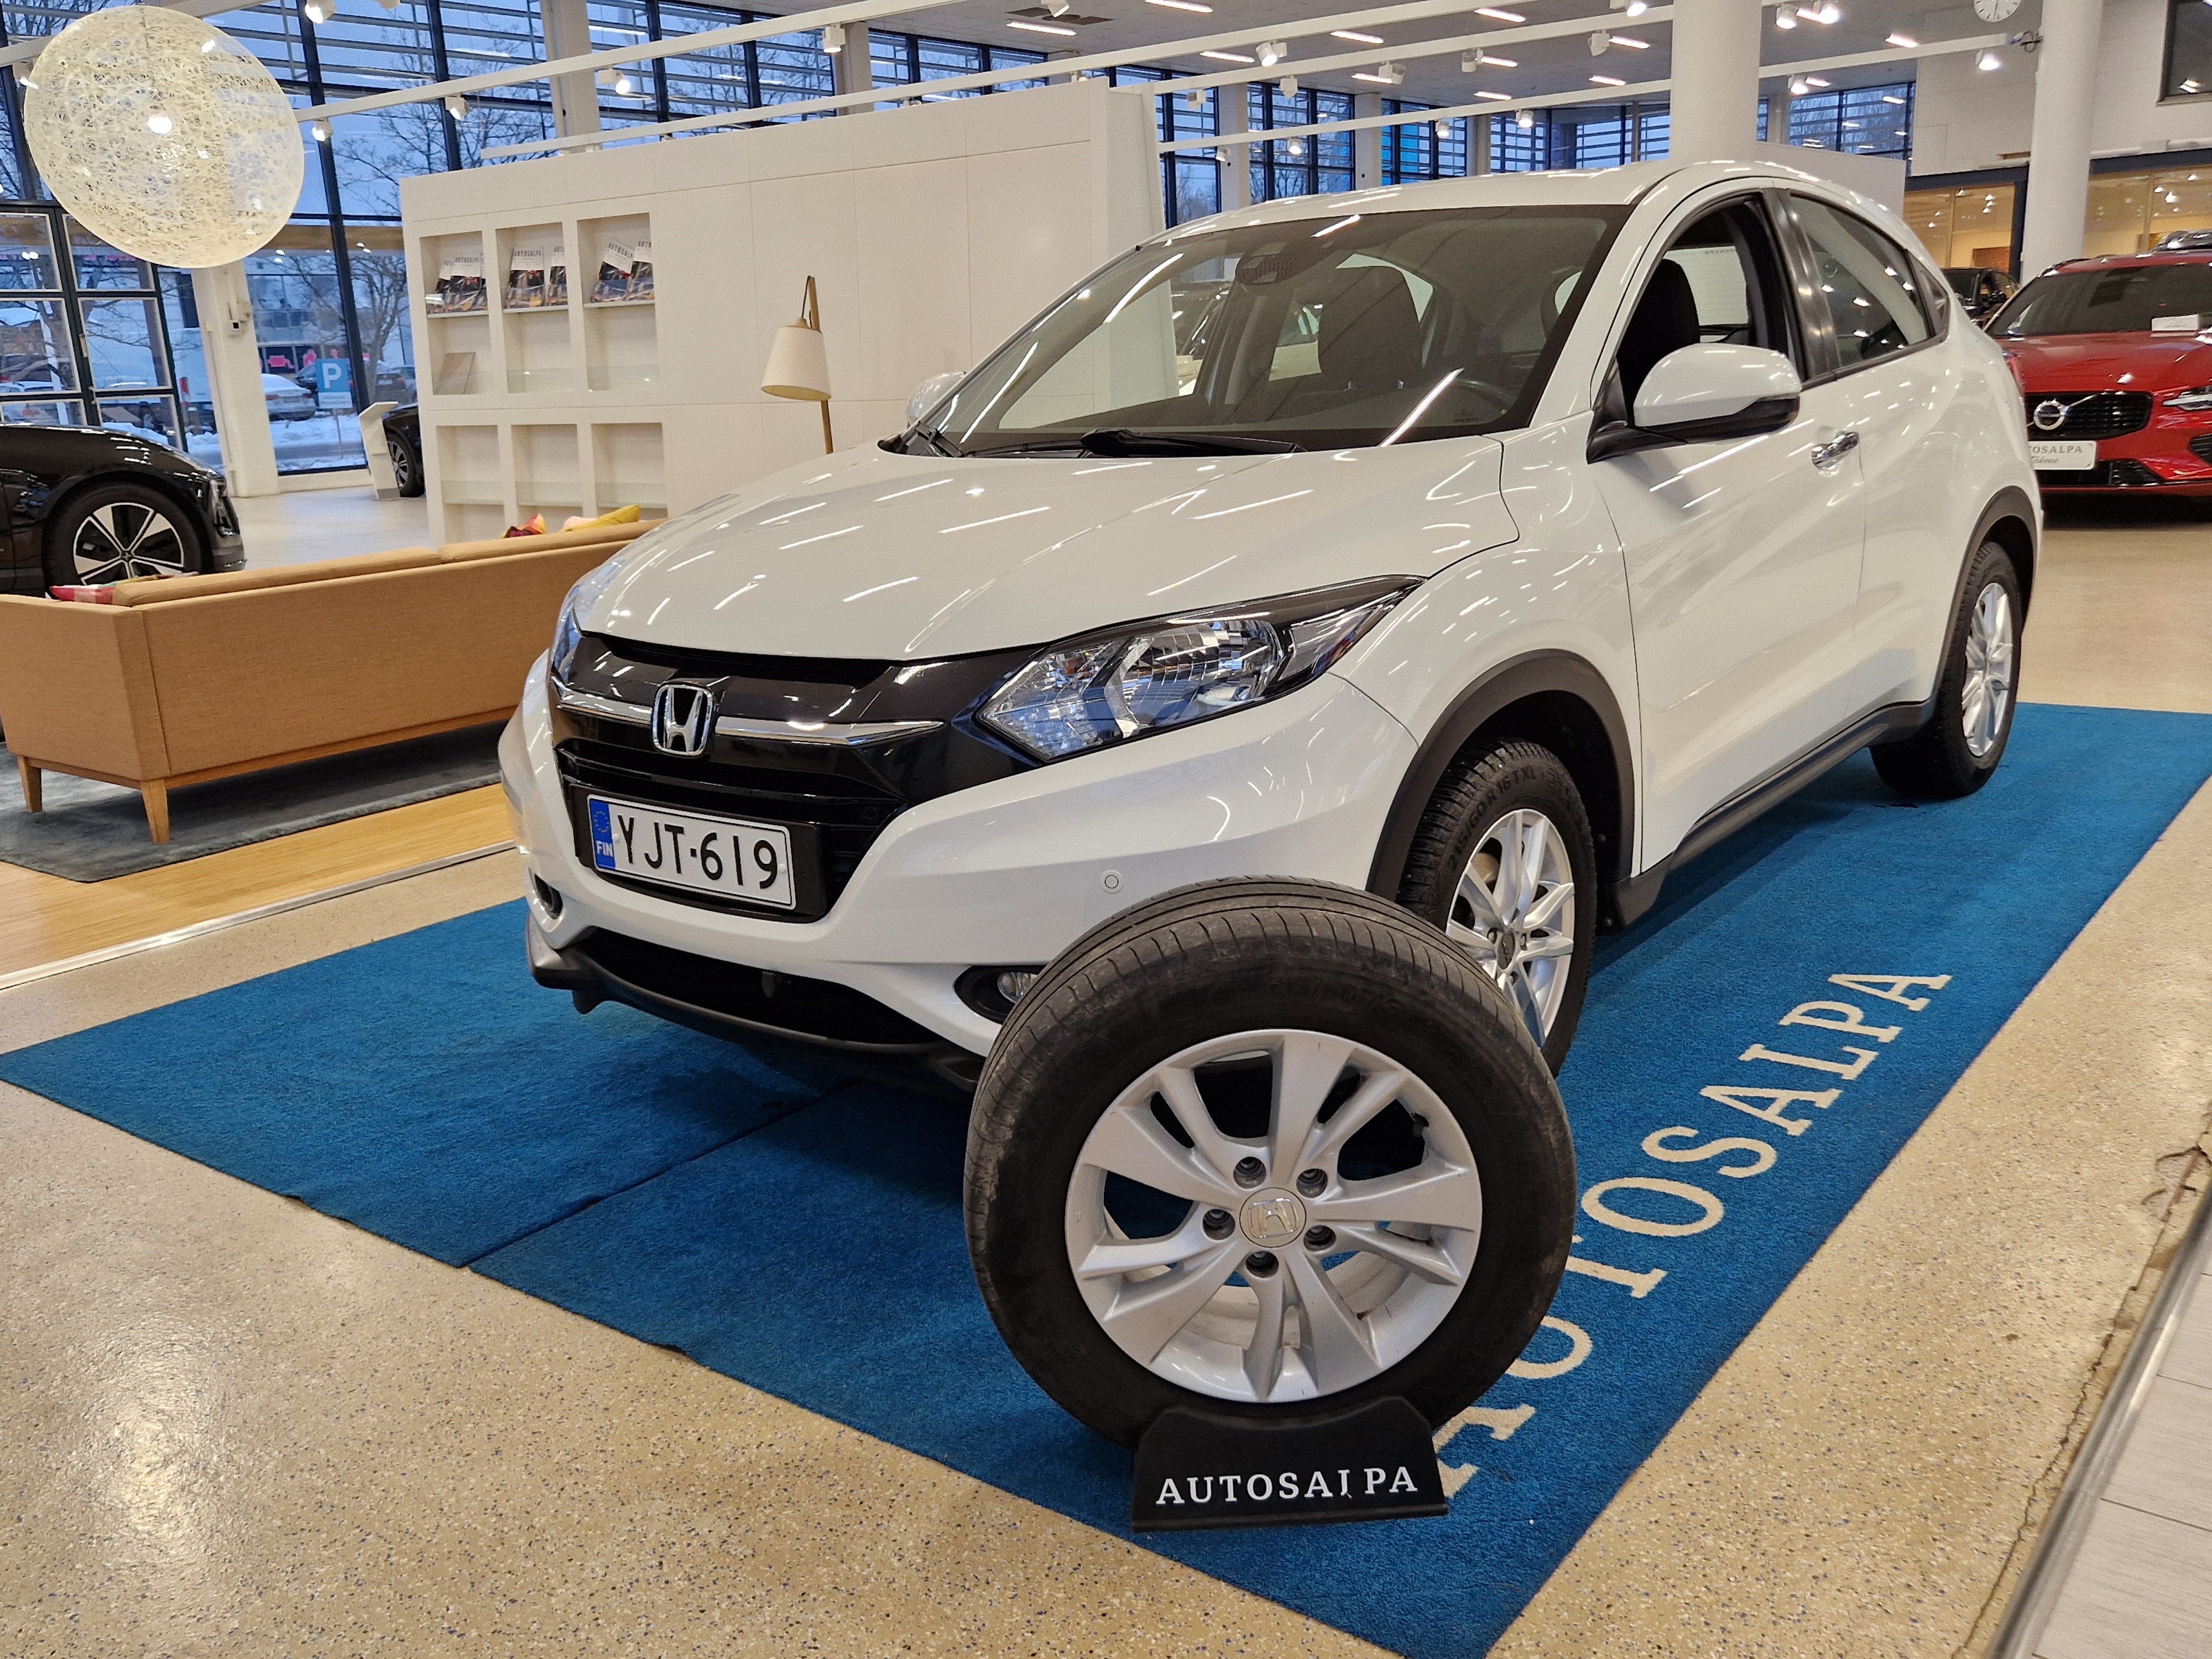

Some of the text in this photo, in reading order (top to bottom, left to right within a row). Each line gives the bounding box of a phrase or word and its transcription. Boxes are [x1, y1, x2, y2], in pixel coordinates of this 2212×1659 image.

[608, 242, 634, 259] AUTOSALP
[322, 363, 342, 389] P
[596, 840, 614, 857] FIN
[618, 815, 778, 889] YJT-619
